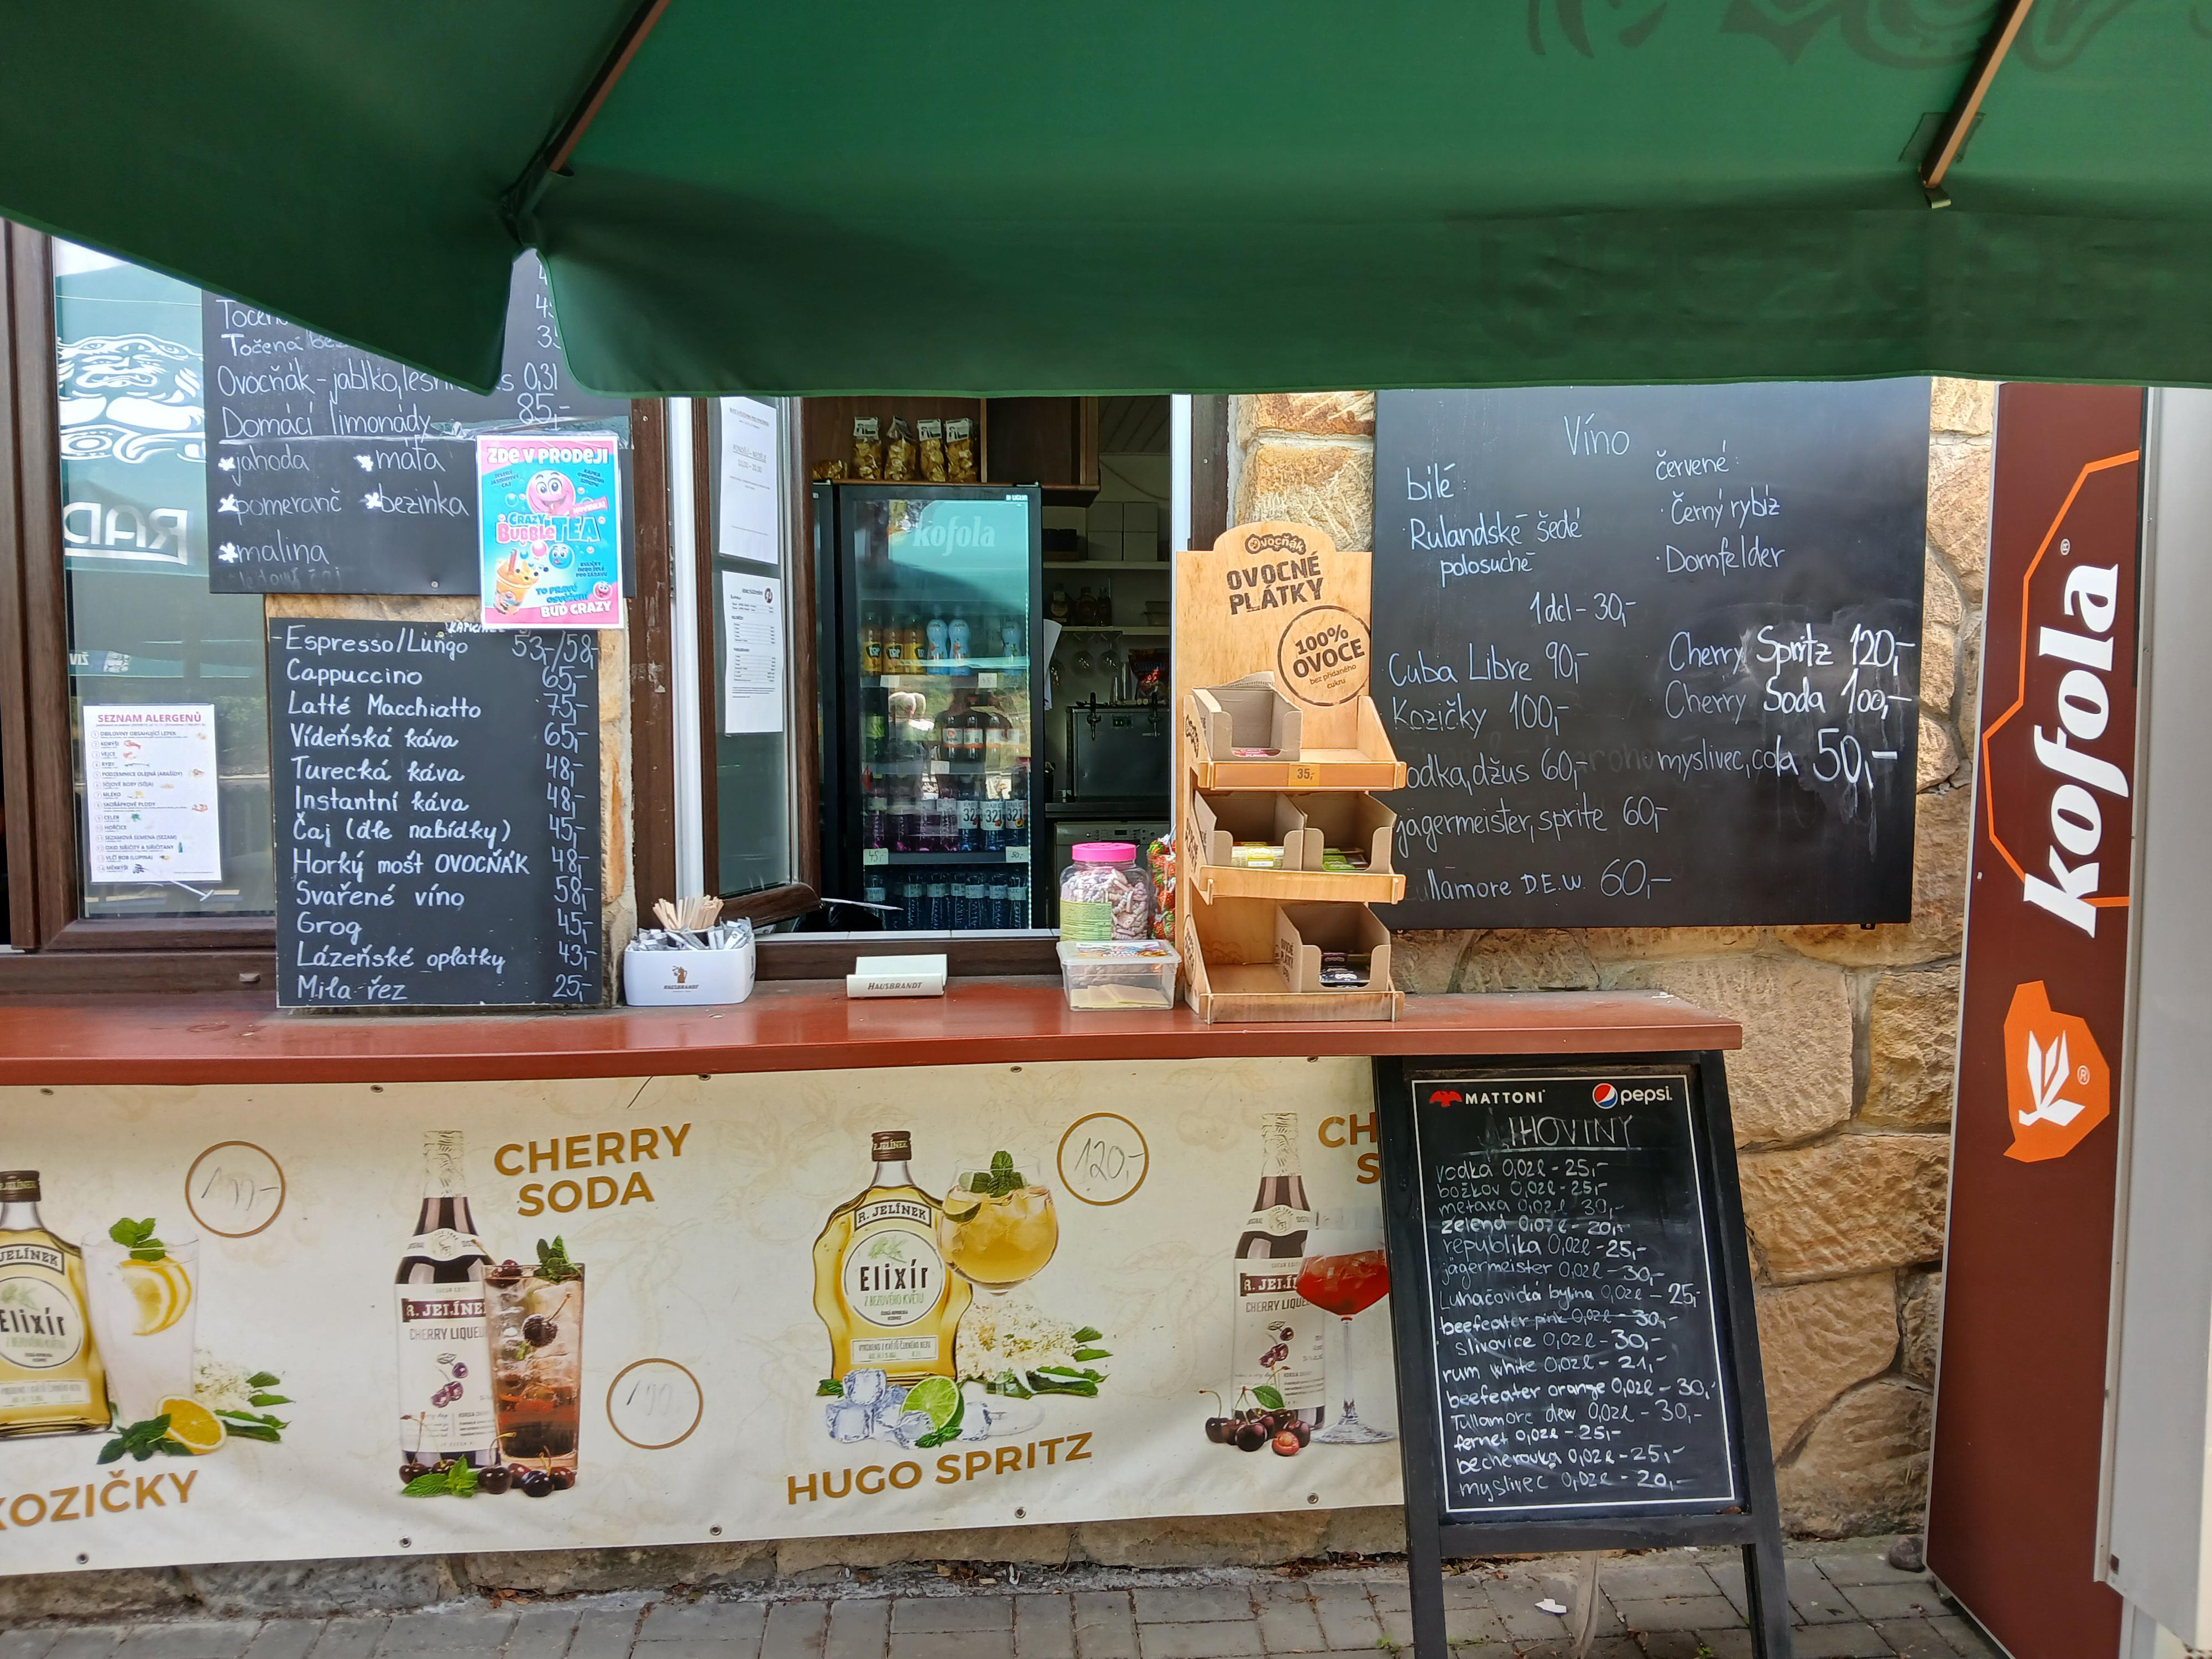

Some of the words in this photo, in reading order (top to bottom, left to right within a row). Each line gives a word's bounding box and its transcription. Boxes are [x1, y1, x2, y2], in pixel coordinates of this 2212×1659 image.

[221, 333, 304, 357] Točená
[217, 359, 316, 397] Ovocňák
[221, 401, 314, 438] Domácí
[330, 401, 432, 441] limonády
[1563, 413, 1630, 456] Víno
[233, 444, 310, 486] jahoda
[375, 437, 445, 472] máta
[523, 447, 537, 464] V
[234, 487, 342, 525] pomeranč
[378, 481, 469, 517] bezinka
[507, 512, 546, 526] CRAZY
[1671, 487, 1724, 528] Černý
[1730, 484, 1781, 529] rybíz
[552, 515, 601, 542] TEA
[912, 516, 995, 556] kofola
[1246, 533, 1306, 554] Ovocňák
[1410, 510, 1530, 550] Rulandské
[1537, 507, 1583, 543] šedé
[237, 529, 330, 565] malina
[1666, 534, 1786, 576] Dornfelder
[1227, 551, 1322, 591] OVOCNÉ
[1441, 550, 1536, 588] polosuché
[570, 601, 612, 616] CRAZY
[1229, 577, 1323, 615] PLÁTKY
[285, 624, 468, 661] Espresso/Lungo
[1295, 624, 1349, 655] 100%
[1669, 631, 1746, 675] Cherry
[1755, 623, 1834, 676] Spritz
[1850, 623, 1916, 676] 120,-
[1292, 638, 1365, 679] OVOCE
[1310, 675, 1323, 685] bez
[1323, 664, 1357, 683] přidaného
[1389, 650, 1459, 687] Cuba
[1469, 643, 1533, 681] Libre
[1545, 640, 1589, 685] 90,-
[286, 658, 423, 686] Cappuccino
[541, 665, 587, 695] 65,-
[1327, 677, 1347, 690] cukru
[288, 690, 351, 716] Latté
[367, 693, 482, 718] Macchiatto
[1392, 692, 1487, 739] Kozičky
[1509, 691, 1569, 736] 100,-
[1665, 679, 1747, 724] Cherry
[1763, 676, 1826, 713] Soda
[98, 714, 142, 723] SEZNAM
[145, 712, 202, 723] ALERGENŮ
[290, 722, 393, 748] Vídeňská
[405, 726, 459, 748] káva
[544, 722, 589, 754] 65,-
[2022, 563, 2130, 939] kofola
[290, 755, 392, 782] Turecká
[408, 759, 466, 782] káva
[545, 753, 585, 787] 48,-
[1406, 752, 1530, 796] odka,džus
[1541, 748, 1588, 791] 60,-
[1813, 728, 1898, 789] 50,-
[295, 785, 399, 812] Instantní
[411, 790, 469, 812] káva
[546, 782, 586, 818] 48,-
[1623, 795, 1668, 833] 60,-
[293, 812, 331, 848] Čaj
[409, 818, 510, 849] nabídky)
[549, 814, 586, 848] 45,-
[293, 848, 364, 882] Horký
[378, 851, 424, 875] mošt
[435, 848, 530, 875] OVOCŇÁK
[552, 844, 590, 879] 48,-
[1600, 858, 1672, 899] 60,-
[296, 881, 395, 907] Svařené
[415, 884, 465, 907] víno
[554, 876, 594, 911] 58,-
[297, 912, 362, 946] Grog
[297, 941, 414, 968] Lázeňské
[426, 947, 506, 974] oplatky
[298, 974, 352, 999] Mila
[367, 976, 408, 1000] řez
[552, 974, 593, 1001] 25,-
[868, 982, 923, 992] HAUSBRANDT
[1465, 1089, 1543, 1105] MATTONI
[1620, 1086, 1670, 1106] pepsi
[494, 1123, 692, 1176] CHERRY
[1436, 1160, 1493, 1183] vodka
[517, 1171, 655, 1217] SODA
[1437, 1181, 1500, 1198] božkov
[872, 1202, 926, 1220] JELÍNEK
[1438, 1198, 1511, 1217] metaxa
[1441, 1213, 1507, 1234] zelená
[1442, 1233, 1542, 1262] republika
[860, 1258, 930, 1292] Elixír
[1442, 1256, 1553, 1289] jägermeister
[1246, 1300, 1280, 1313] CHERRY
[1548, 1284, 1595, 1311] bylina
[409, 1328, 448, 1340] CHERRY
[1454, 1334, 1537, 1357] Slivovice
[1442, 1367, 1481, 1383] rum
[1490, 1359, 1538, 1380] white
[1446, 1385, 1541, 1409] beefeater
[1547, 1381, 1606, 1399] orange
[1450, 1411, 1534, 1431] Tullamore
[1546, 1403, 1577, 1423] dew
[1453, 1430, 1509, 1452] fernet
[787, 1460, 922, 1505] HUGO
[935, 1431, 1093, 1484] SPRITZ
[1457, 1450, 1562, 1475] becherovka
[1459, 1474, 1549, 1502] myslivec
